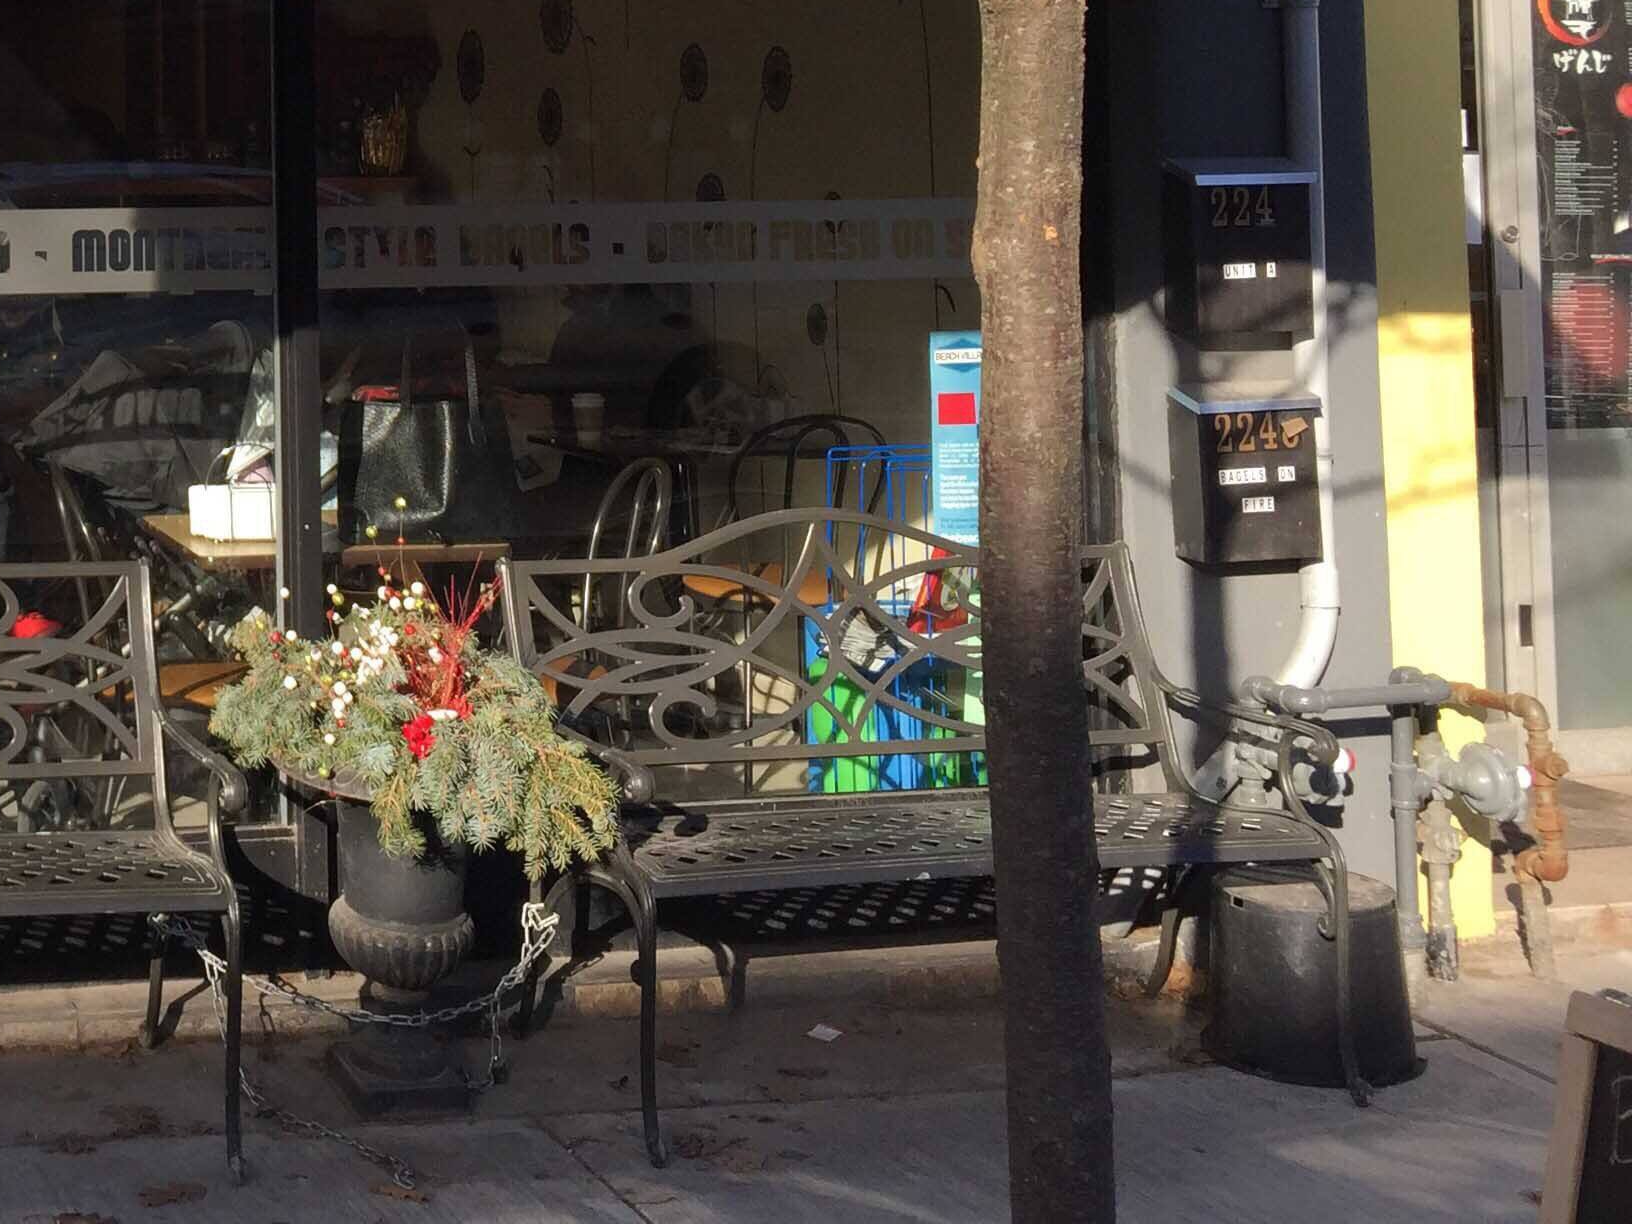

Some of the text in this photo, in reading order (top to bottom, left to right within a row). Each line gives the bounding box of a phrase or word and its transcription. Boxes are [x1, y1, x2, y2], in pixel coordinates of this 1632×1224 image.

[1224, 264, 1254, 278] UNIT
[935, 351, 960, 361] BEACH
[1219, 468, 1266, 484] BAGELS
[1243, 497, 1273, 511] FIRE
